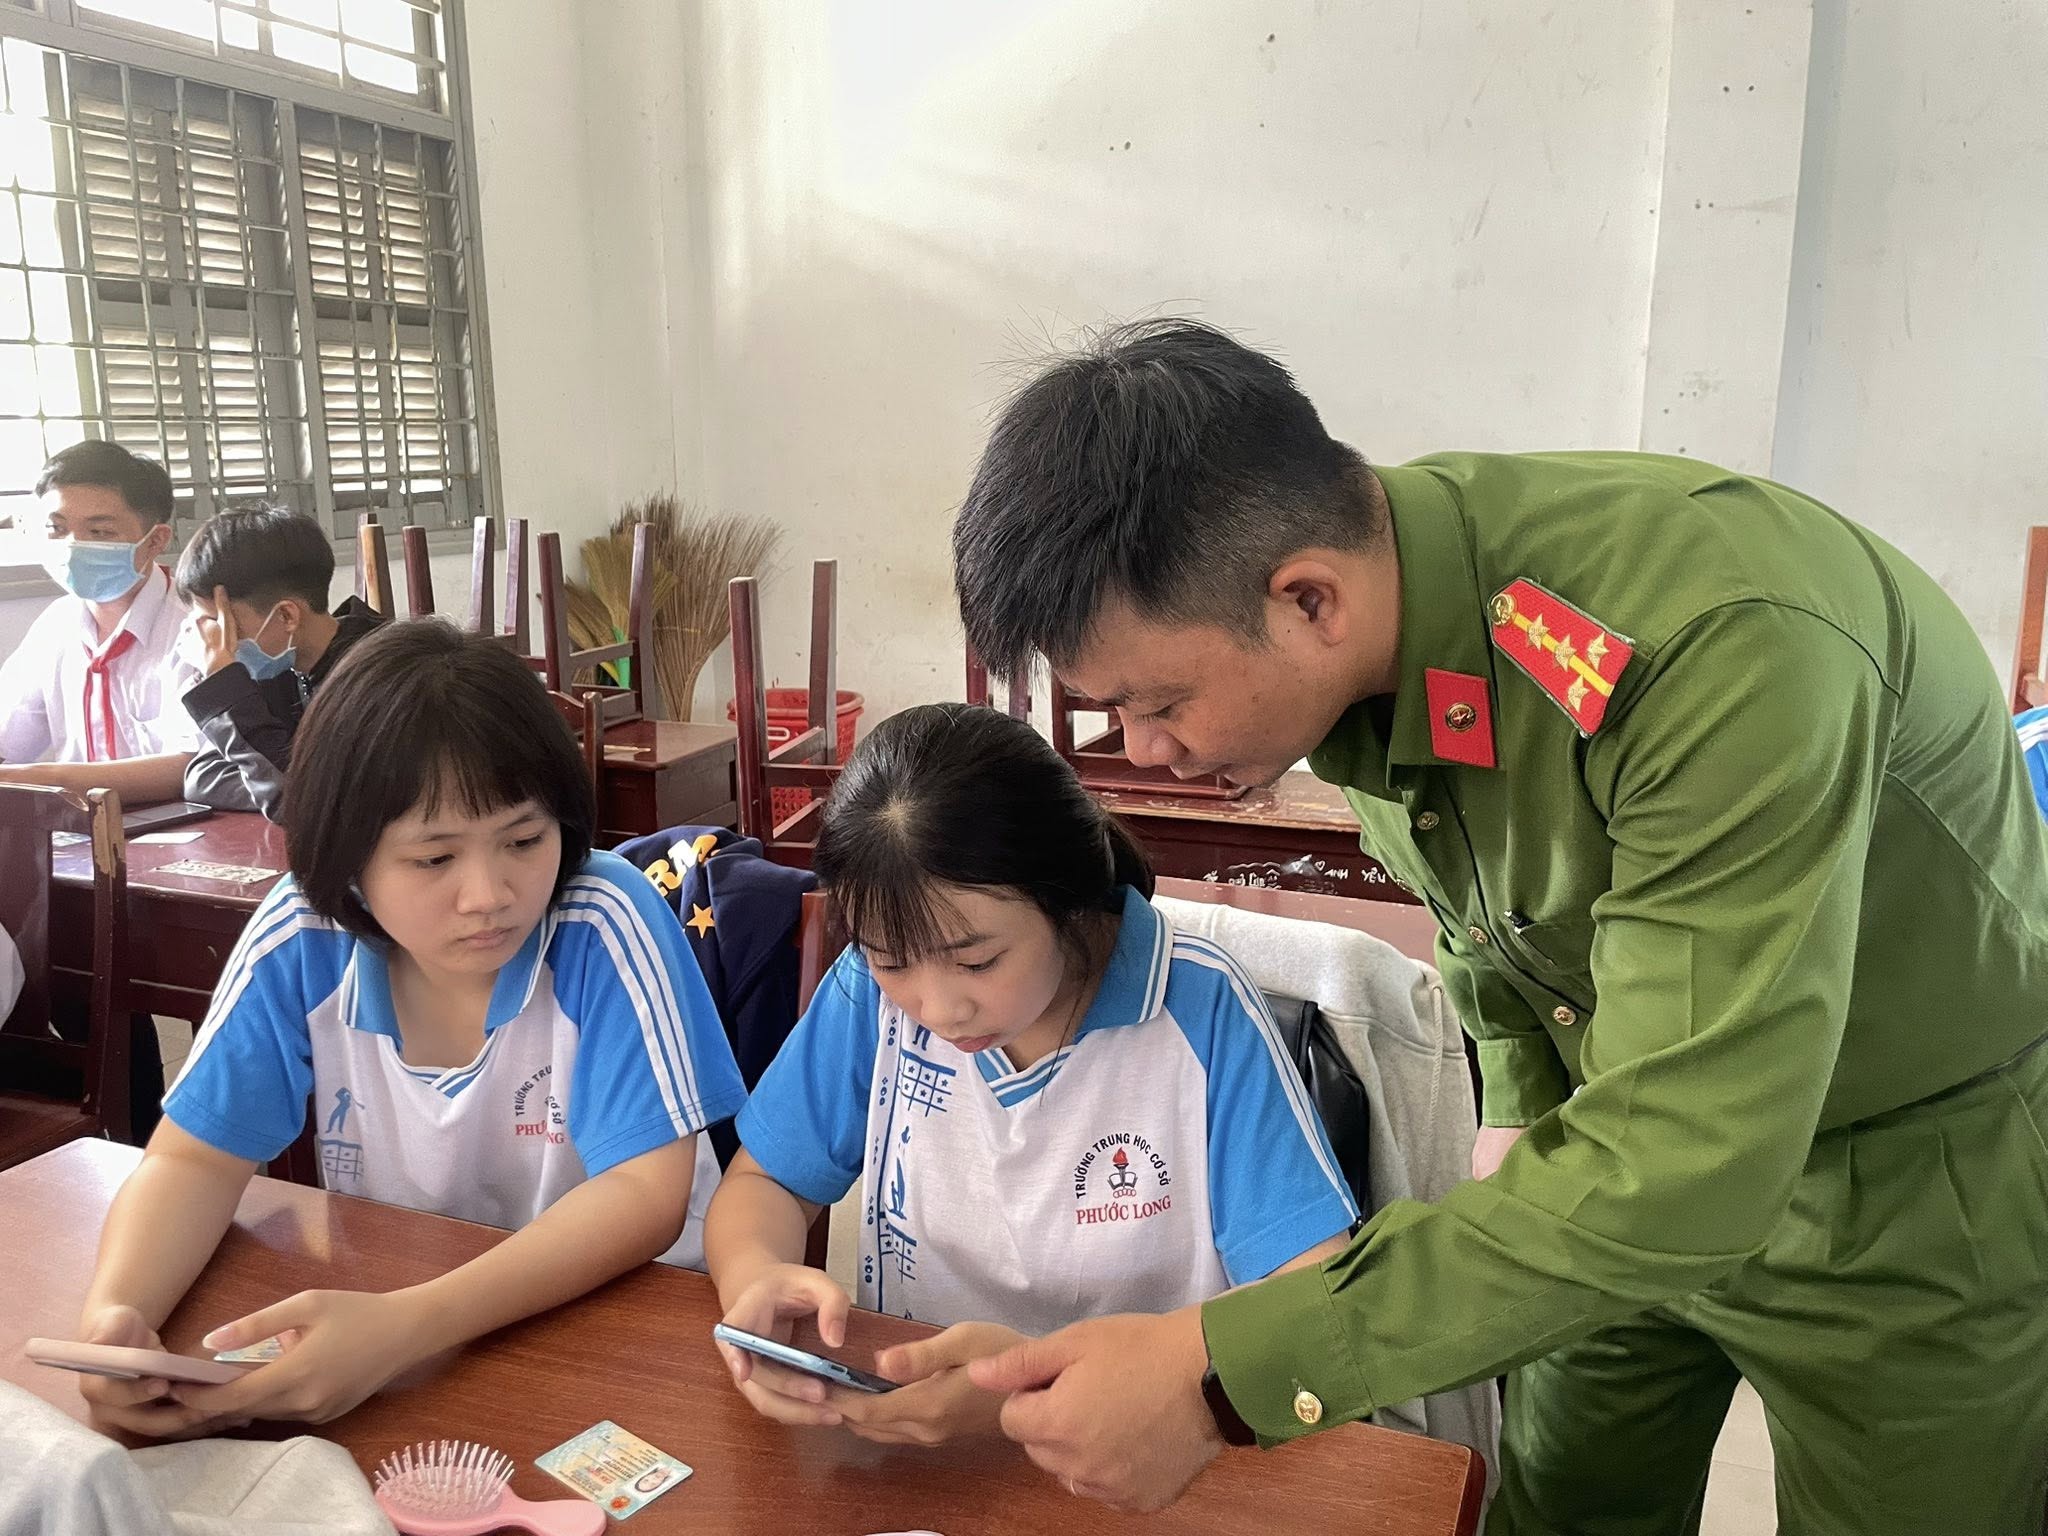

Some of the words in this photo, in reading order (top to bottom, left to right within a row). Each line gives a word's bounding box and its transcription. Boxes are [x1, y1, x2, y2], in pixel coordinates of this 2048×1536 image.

[514, 1081, 534, 1117] TRƯỜNG
[532, 1065, 552, 1082] TRU
[515, 1120, 548, 1136] PHƯ
[547, 1131, 565, 1144] NG
[1092, 1133, 1131, 1153] TRUNG
[1133, 1134, 1152, 1155] HỌC
[1149, 1153, 1167, 1170] CƠ
[1074, 1151, 1096, 1199] TRƯỜNG
[1157, 1170, 1173, 1187] SỞ
[1075, 1201, 1129, 1225] PHƯỚC
[1133, 1195, 1172, 1220] LONG
